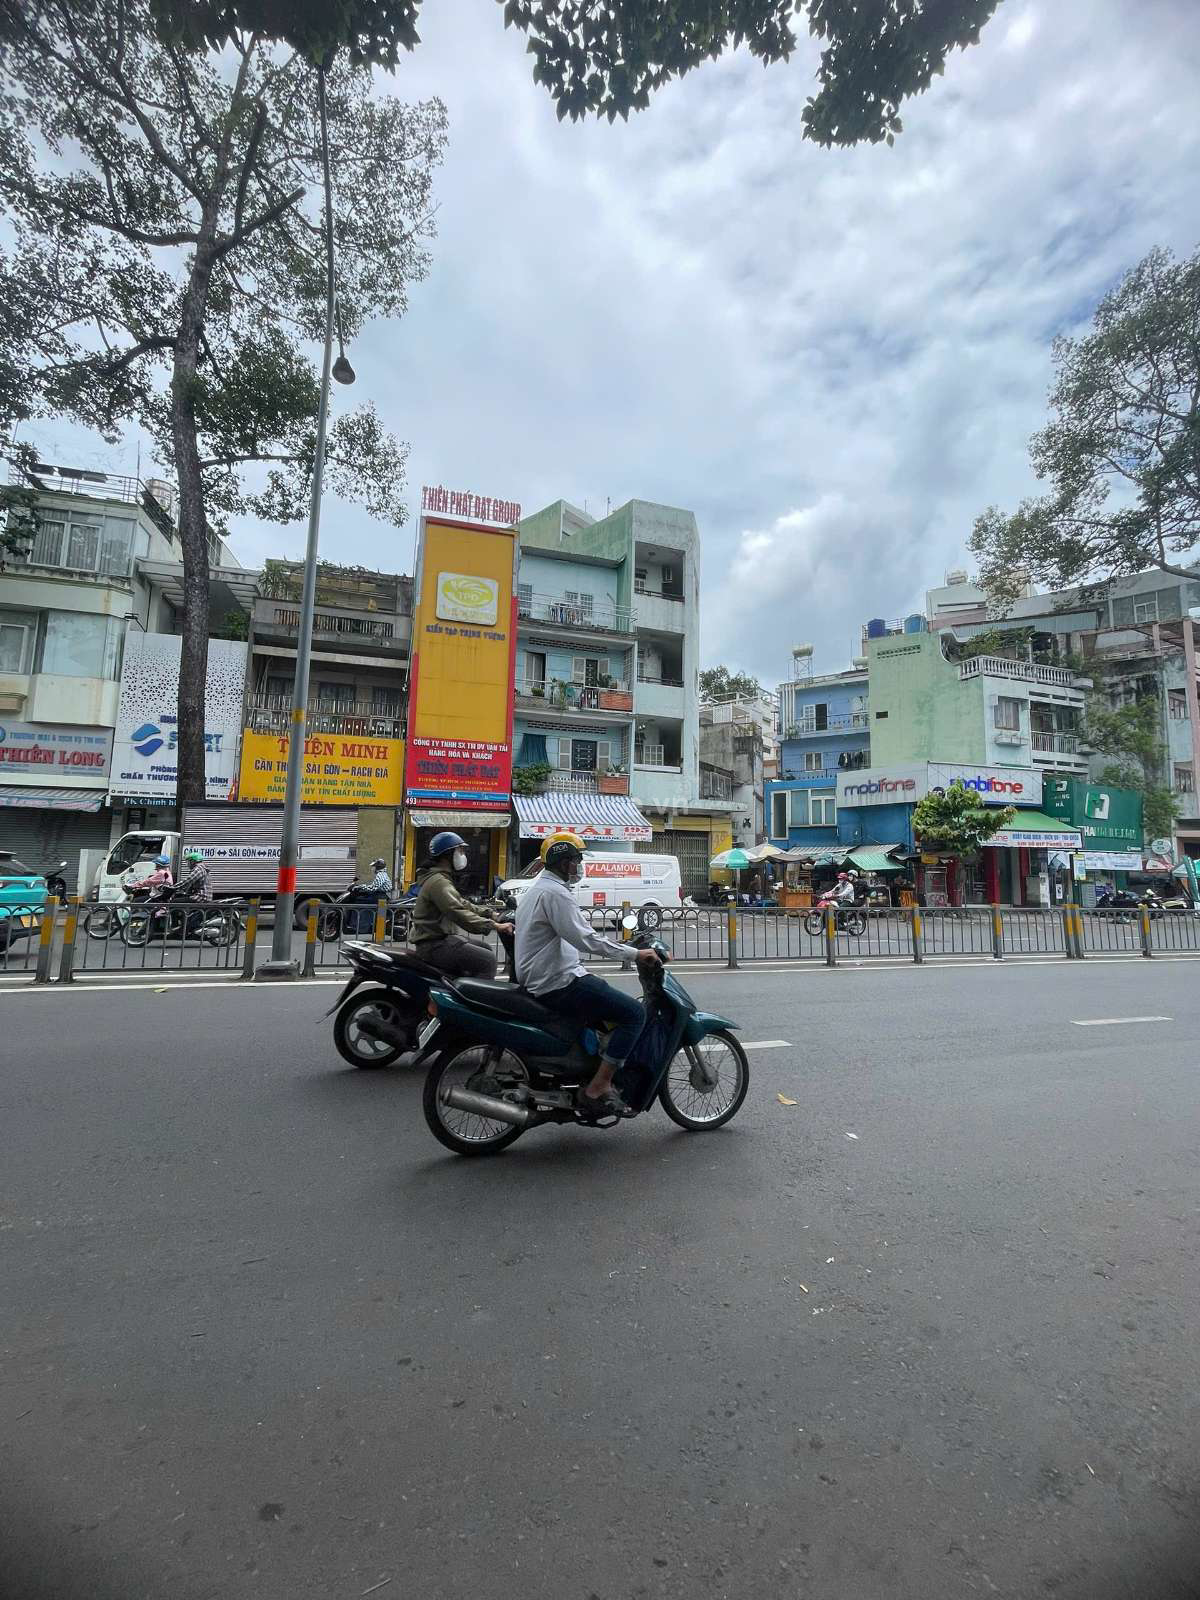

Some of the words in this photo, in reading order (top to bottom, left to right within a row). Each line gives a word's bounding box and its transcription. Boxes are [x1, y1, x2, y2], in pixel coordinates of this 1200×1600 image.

[493, 499, 521, 524] GROUP
[0, 744, 55, 764] THIÊN
[58, 751, 105, 767] LONG
[277, 736, 335, 758] TIỆN
[341, 742, 388, 760] MINH
[844, 777, 916, 797] mobifone
[406, 797, 417, 805] 493
[595, 863, 641, 872] LALAMOVE
